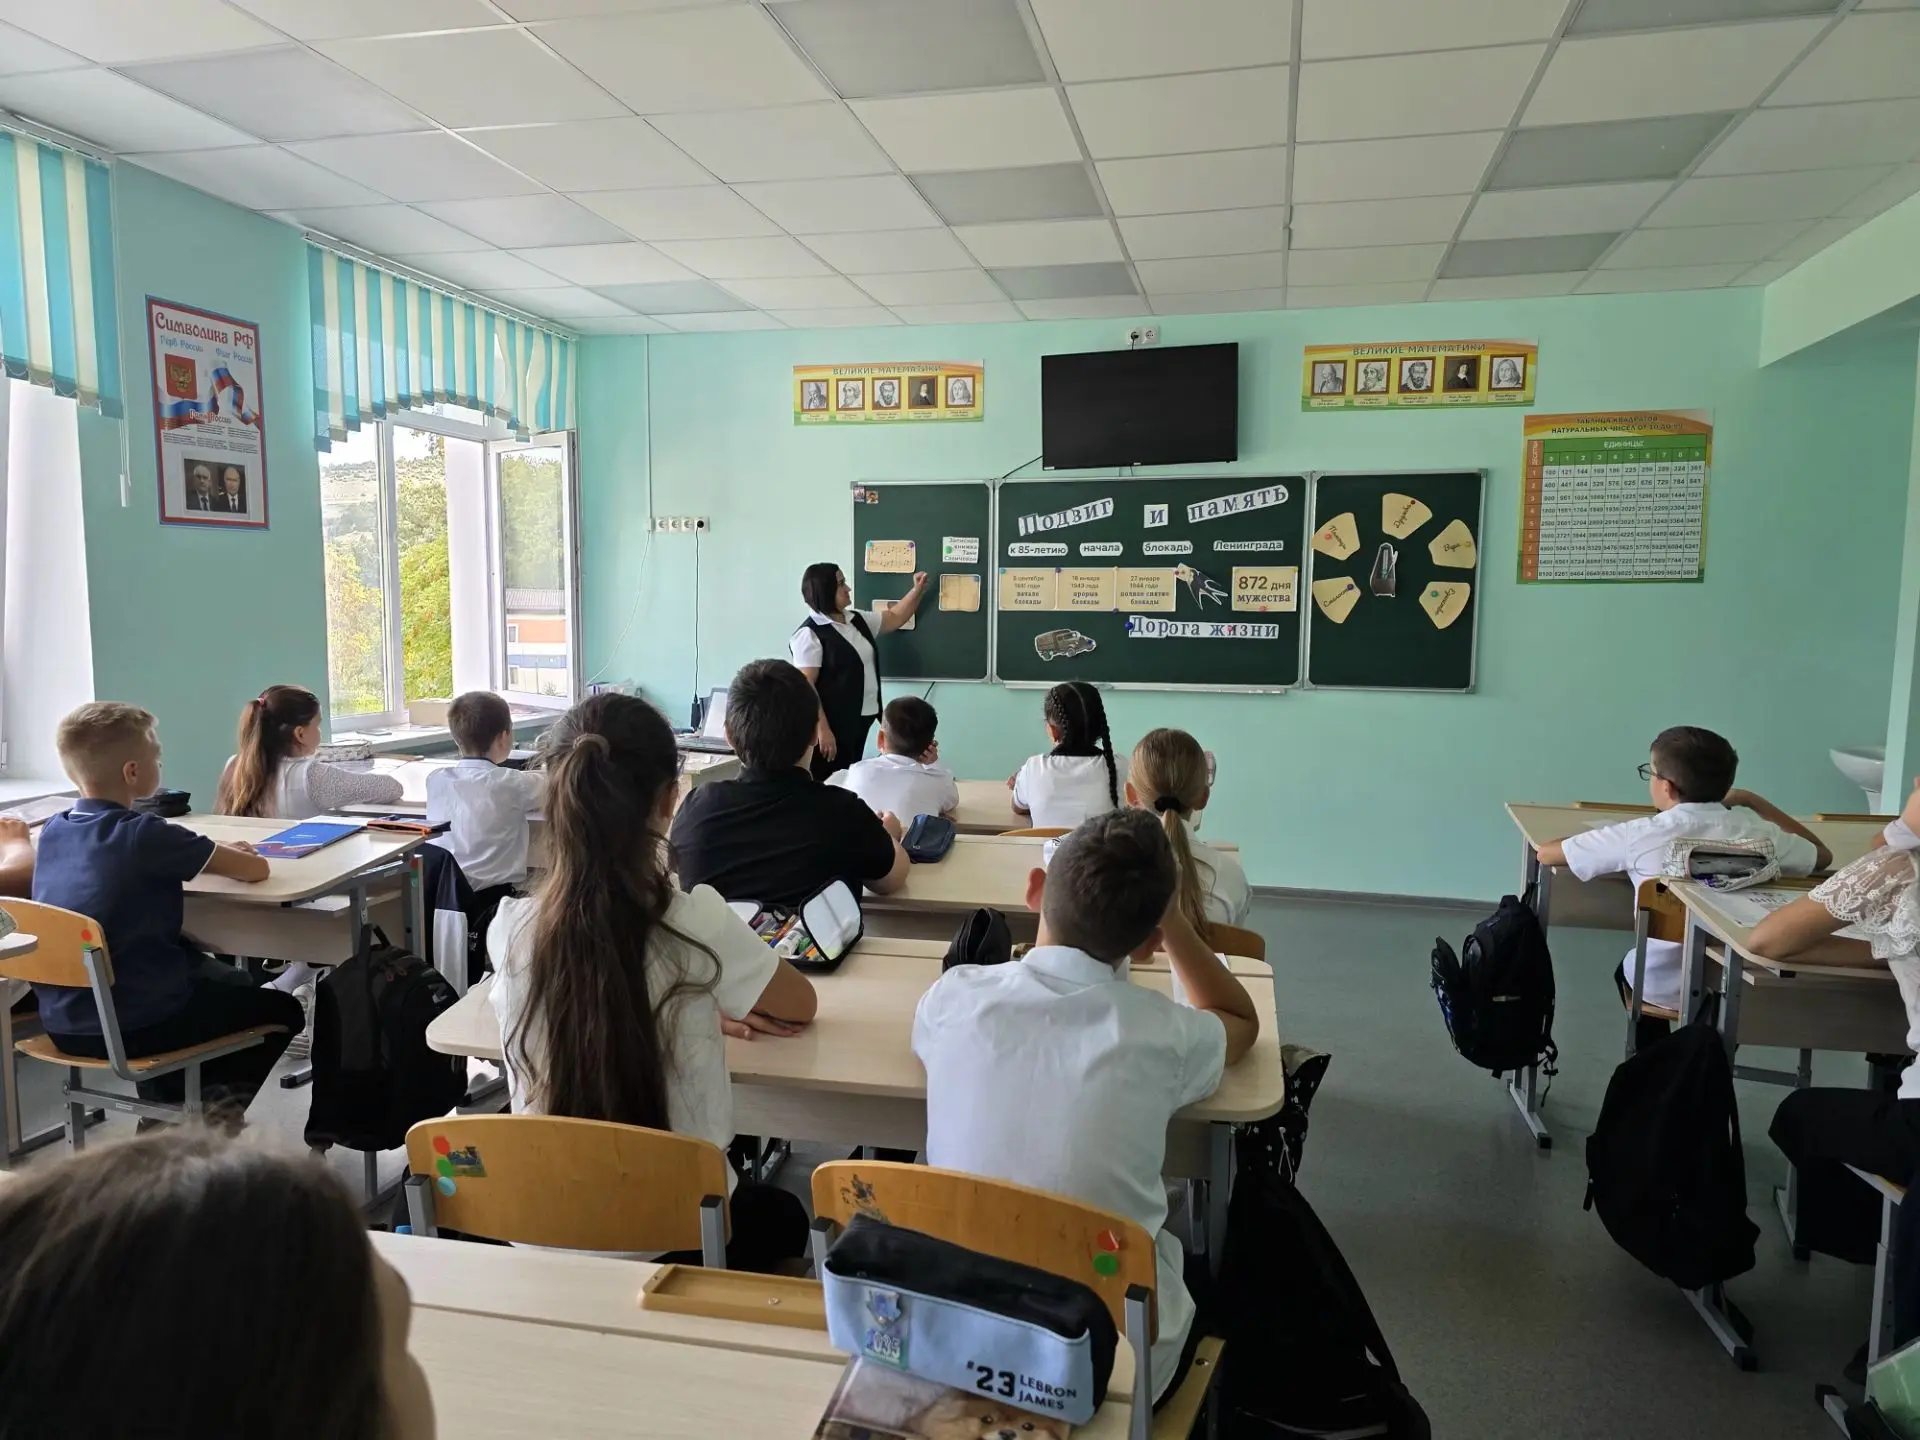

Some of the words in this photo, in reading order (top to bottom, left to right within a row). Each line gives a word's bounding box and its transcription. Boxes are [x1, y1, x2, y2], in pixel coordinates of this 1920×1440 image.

[156, 312, 228, 344] Символика
[234, 331, 254, 349] РФ
[1353, 346, 1404, 356] ВЕЛИКИЕ
[1408, 343, 1486, 353] МАТЕМАТИКИ
[832, 367, 874, 375] ВЕЛИКИЕ
[878, 366, 942, 374] МАТЕМАТИКИ
[1552, 426, 1608, 434] НАТУРАЛЬНЫХ
[1023, 500, 1111, 535] Подвиг
[1150, 510, 1164, 524] и
[1190, 488, 1286, 520] память
[1018, 546, 1066, 554] 85-летию
[1144, 543, 1192, 553] блокады
[1214, 540, 1282, 550] Ленинграда
[1238, 576, 1268, 590] 872
[1270, 582, 1291, 591] дня
[1237, 594, 1290, 604] мужества
[1324, 586, 1351, 608] Смелост
[1130, 616, 1200, 637] Дорога
[1209, 624, 1278, 638] жизни
[1020, 1374, 1077, 1398] LEBRON
[1018, 1390, 1064, 1410] JAMES
